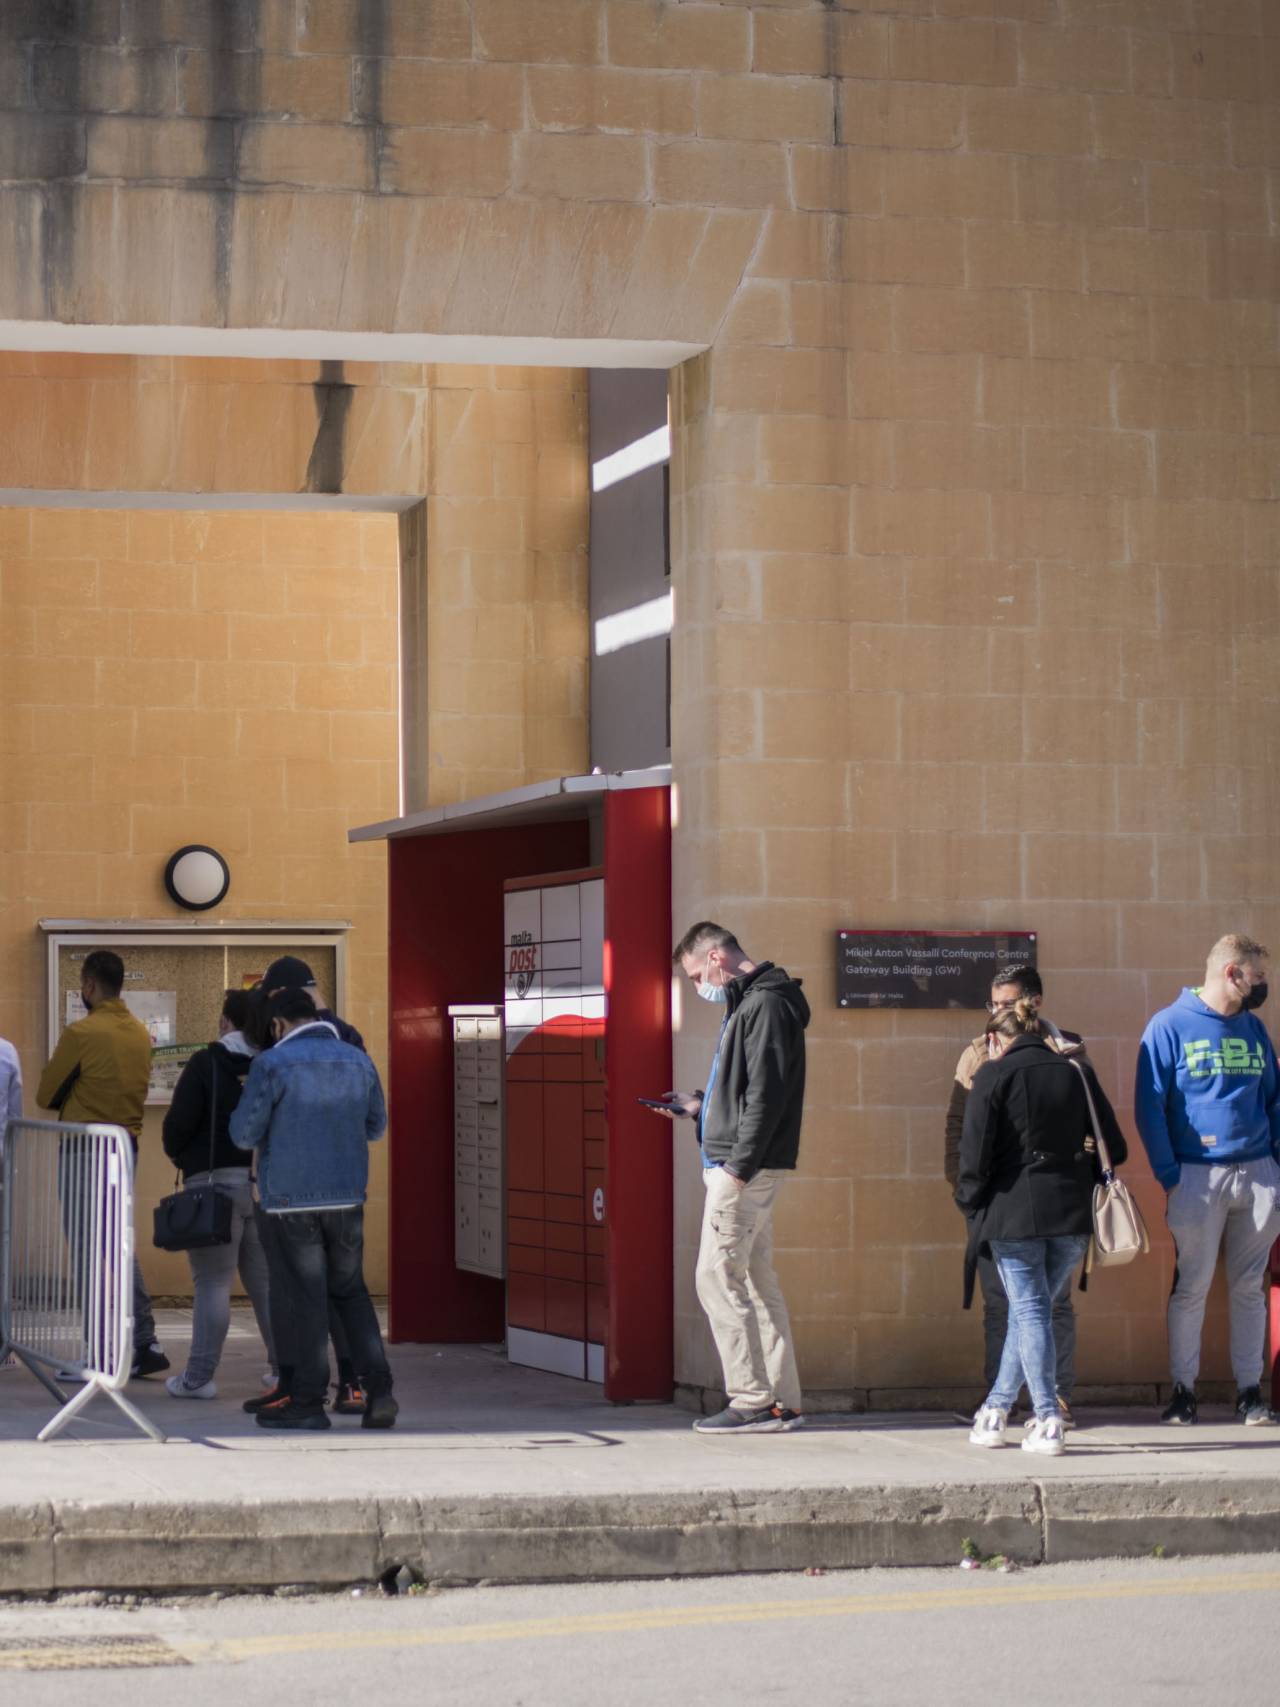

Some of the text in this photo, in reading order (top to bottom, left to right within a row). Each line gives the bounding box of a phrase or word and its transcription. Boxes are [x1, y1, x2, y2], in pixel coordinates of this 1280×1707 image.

[511, 931, 532, 945] malta
[846, 948, 1030, 959] Mikiel Anton Vassalli Conference Centre
[509, 944, 537, 979] post
[846, 965, 961, 977] Gateway Building (GW)
